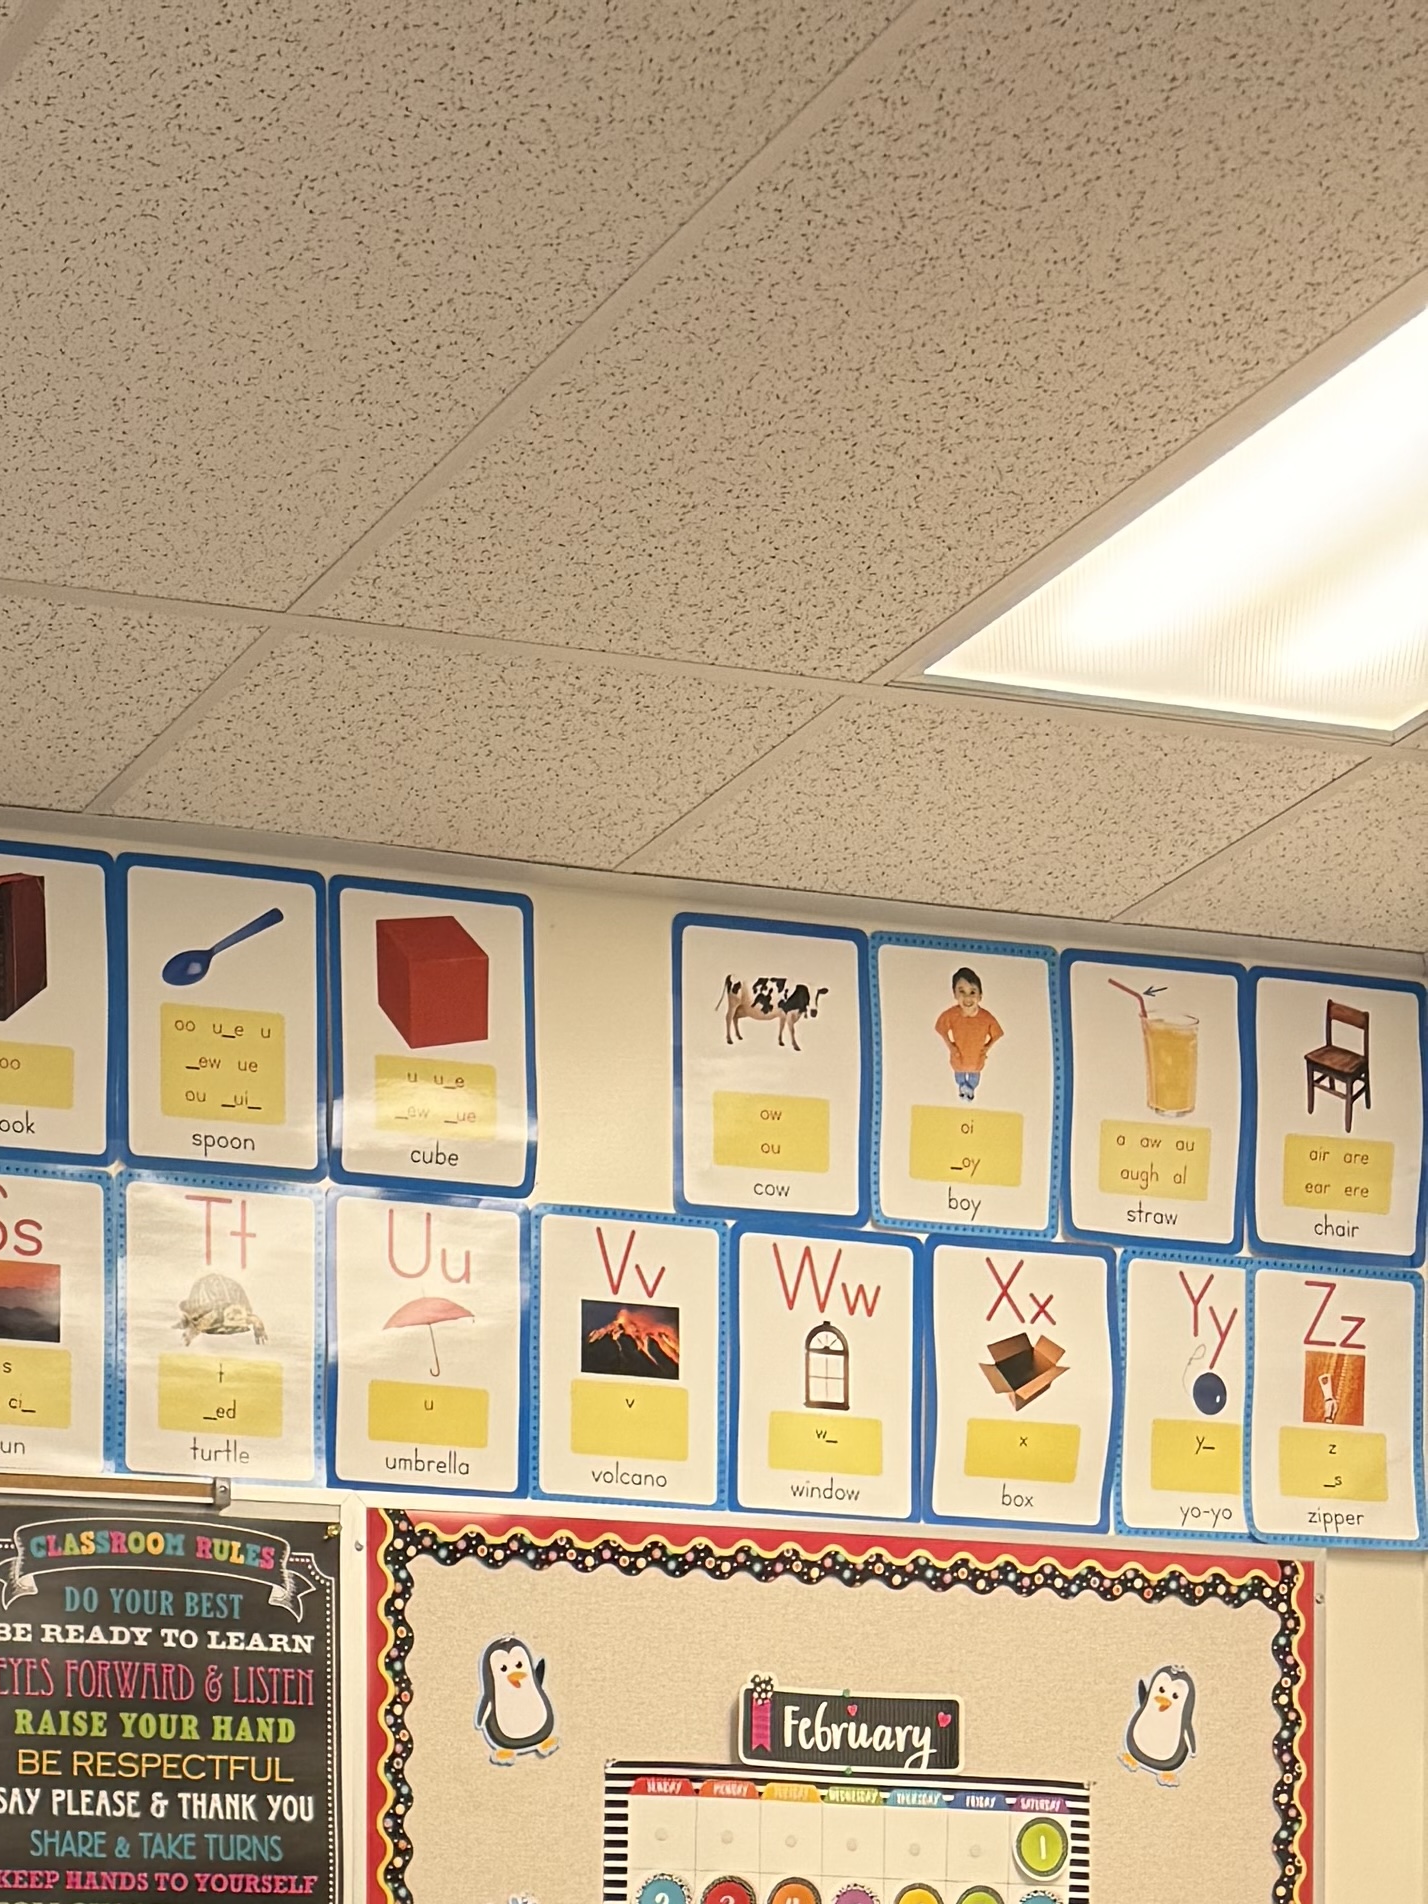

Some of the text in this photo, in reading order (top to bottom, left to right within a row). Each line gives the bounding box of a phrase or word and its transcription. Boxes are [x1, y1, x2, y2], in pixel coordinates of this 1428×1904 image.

[191, 1132, 255, 1158] spoon
[410, 1142, 459, 1167] cube
[754, 1182, 789, 1197] cow
[948, 1189, 981, 1221] boy
[1127, 1206, 1178, 1226] straw
[185, 1195, 256, 1269] Tt
[1314, 1219, 1359, 1238] chair
[596, 1227, 665, 1298] Vv
[772, 1243, 881, 1317] Ww
[1303, 1281, 1366, 1349] Zz
[190, 1438, 249, 1465] turtle
[385, 1454, 469, 1475] umbrella
[591, 1467, 667, 1489] volcano
[791, 1481, 860, 1502] window
[1002, 1487, 1034, 1509] box
[1180, 1505, 1232, 1525] yo-yo
[1308, 1510, 1364, 1531] zipper
[30, 1530, 275, 1570] CLASSROOM RULES
[65, 1587, 243, 1618] DO YOUR BEST
[41, 1624, 152, 1646] READY
[161, 1628, 198, 1648] TO
[207, 1631, 315, 1654] LEARN
[67, 1658, 194, 1702] FORWARD
[205, 1664, 221, 1702] &
[234, 1666, 314, 1705] LISTEN
[783, 1702, 937, 1769] February
[18, 1750, 294, 1782] BE RESPECTFUL
